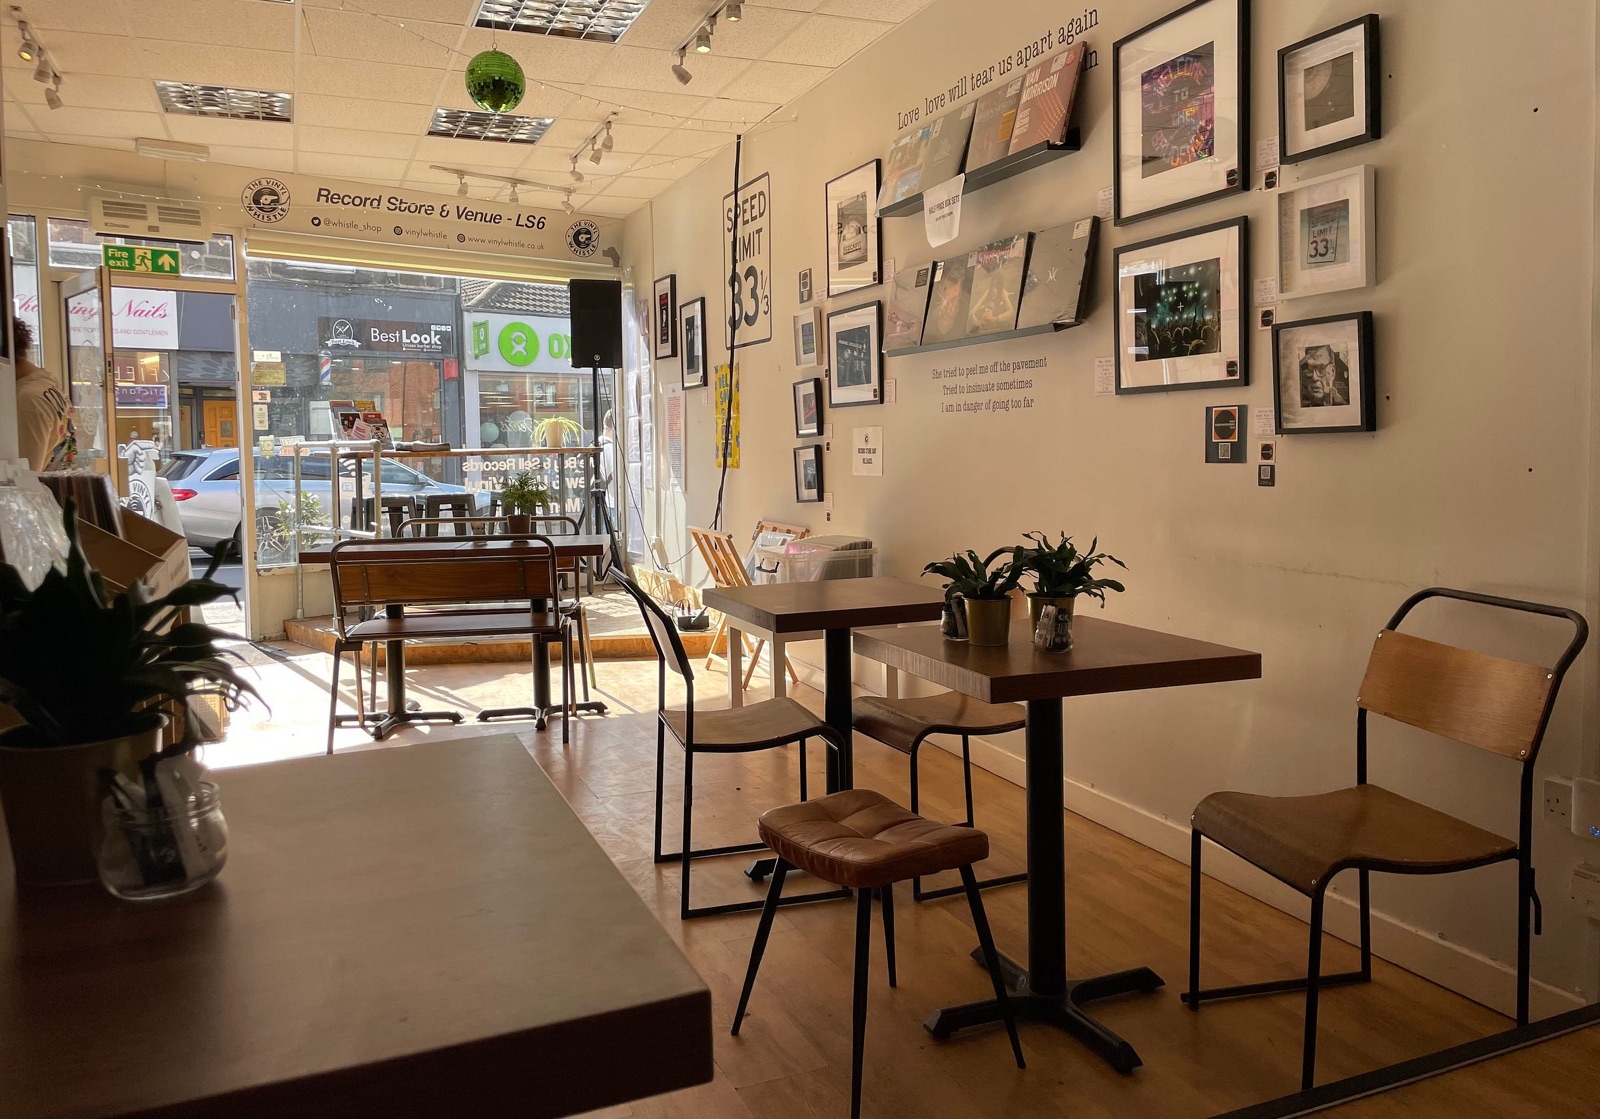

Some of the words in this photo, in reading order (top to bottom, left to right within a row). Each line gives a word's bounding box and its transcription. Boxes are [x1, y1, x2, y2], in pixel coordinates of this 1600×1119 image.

[897, 106, 920, 131] Love
[924, 92, 946, 116] love
[948, 75, 968, 103] will
[970, 64, 995, 92] tear
[998, 52, 1013, 76] us
[1016, 29, 1053, 69] apart
[1057, 8, 1099, 45] again
[1026, 67, 1042, 87] VAN
[1021, 72, 1060, 104] MORRISON
[247, 180, 263, 191] THE
[265, 180, 288, 196] VINYL
[246, 203, 287, 221] WHISTLE
[316, 187, 382, 209] Record
[386, 196, 435, 215] Store
[439, 204, 450, 218] &
[456, 205, 503, 224] Venue
[515, 213, 547, 230] LS6
[726, 190, 767, 233] SPEED
[323, 218, 382, 233] @whistle_shop
[405, 228, 448, 240] vinylwhistle
[467, 236, 545, 250] www.vinylwhistle.co.uk
[570, 221, 582, 231] THE
[584, 221, 598, 234] VINYL
[1312, 226, 1333, 239] LIMIT
[108, 248, 129, 258] Fire
[568, 241, 597, 256] WHISTLE
[730, 227, 763, 265] LIMIT
[1309, 237, 1330, 259] 33
[108, 259, 130, 268] exit
[370, 327, 400, 343] Best
[401, 329, 442, 345] Look
[931, 369, 943, 379] She
[943, 366, 957, 378] tried
[958, 367, 965, 377] to
[965, 364, 978, 378] peel
[979, 365, 989, 375] me
[989, 361, 999, 373] off
[999, 360, 1011, 371] the
[1012, 356, 1048, 373] pavement
[942, 384, 958, 396] Tried
[958, 384, 965, 394] to
[966, 380, 995, 394] insinuate
[996, 378, 1033, 392] sometimes
[945, 404, 955, 413] am
[955, 401, 962, 412] in
[962, 400, 984, 414] danger
[984, 398, 992, 410] of
[992, 398, 1010, 413] going
[1010, 398, 1022, 409] too
[1023, 396, 1035, 408] far
[133, 483, 150, 508] VINYL
